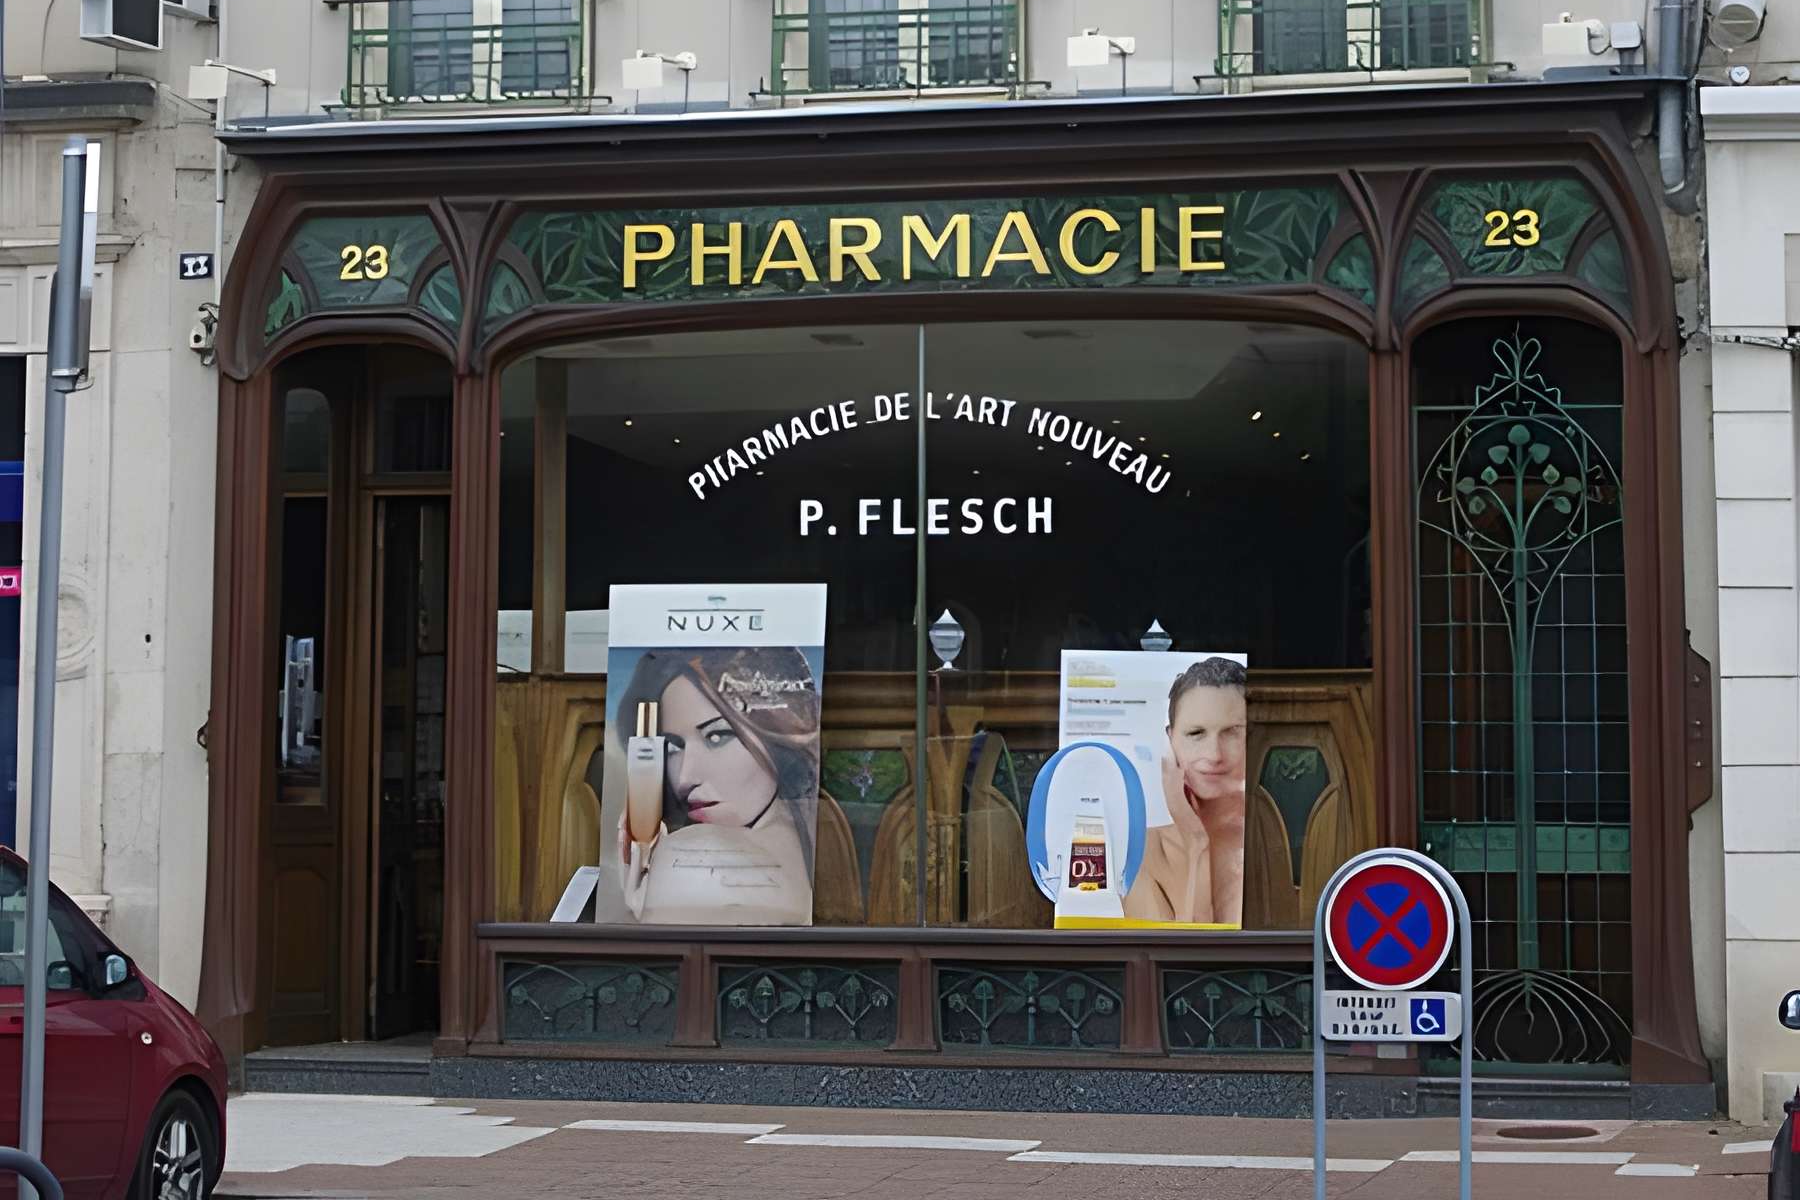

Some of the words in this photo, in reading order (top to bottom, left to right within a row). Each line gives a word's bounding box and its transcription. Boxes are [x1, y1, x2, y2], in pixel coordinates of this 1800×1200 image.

[623, 205, 1225, 288] PHARMACIE
[1484, 209, 1541, 247] 23
[340, 245, 389, 280] 23
[688, 400, 858, 500] PHARMACIE
[874, 392, 910, 422] DE
[926, 391, 1017, 427] L'ART
[1027, 407, 1171, 493] NOUVEAU
[800, 499, 837, 536] P.
[859, 497, 1052, 536] FLESCH
